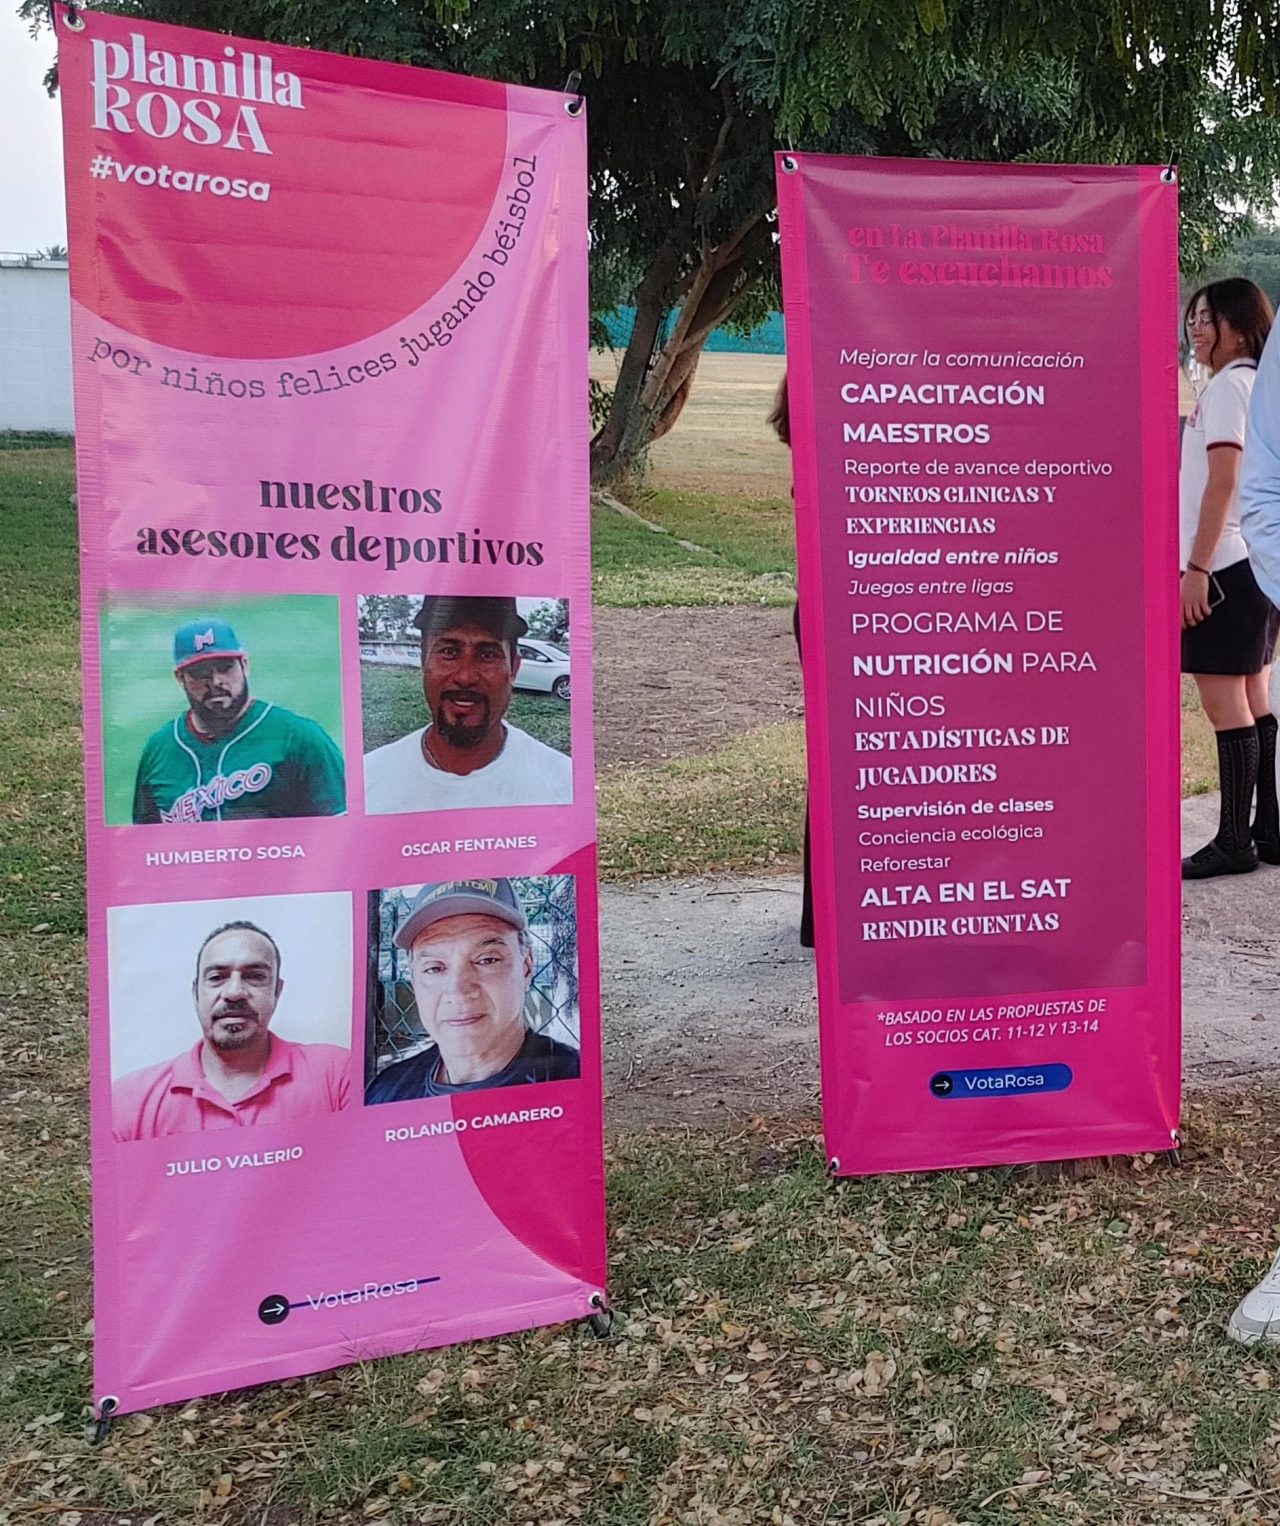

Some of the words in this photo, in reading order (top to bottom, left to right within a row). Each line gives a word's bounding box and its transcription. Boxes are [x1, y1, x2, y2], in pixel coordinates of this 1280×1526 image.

[90, 33, 305, 109] planilla
[90, 80, 273, 155] ROSA
[89, 155, 271, 202] #votarosa
[850, 226, 884, 248] en
[931, 224, 1033, 251] Planilla
[1040, 228, 1104, 254] Rosa
[88, 336, 152, 377] por
[162, 364, 265, 399] niños
[276, 352, 398, 398] felices
[400, 270, 496, 367] jugando
[483, 154, 536, 268] béisbol
[843, 252, 890, 286] Te
[900, 255, 1114, 289] escuchamos
[839, 348, 918, 369] Mejorar
[923, 349, 940, 367] la
[946, 351, 1084, 369] comunicación
[840, 381, 1045, 405] CAPACITACIÓN
[843, 422, 991, 444] MAESTROS
[844, 459, 920, 477] Reporte
[925, 459, 949, 475] de
[954, 462, 1020, 476] avance
[1025, 459, 1112, 478] deportivo
[259, 478, 442, 514] nuestros
[845, 486, 941, 503] TORNEOS
[943, 486, 1039, 503] CLINICAS
[1042, 486, 1057, 503] Y
[846, 517, 996, 535] EXPERIENCIAS
[136, 524, 320, 561] asesores
[330, 525, 544, 571] deportivos
[848, 548, 940, 568] Igualdad
[945, 550, 999, 564] entre
[1003, 548, 1059, 564] niños
[848, 580, 914, 598] Juegos
[918, 580, 967, 595] entre
[971, 578, 1014, 597] ligas
[852, 611, 1018, 634] PROGRAMA
[1026, 610, 1064, 632] DE
[853, 648, 1014, 676] NUTRICIÓN
[1021, 651, 1097, 673] PARA
[855, 692, 946, 718] NIÑOS
[855, 726, 1035, 751] ESTADÍSTICAS
[1040, 726, 1070, 746] DE
[855, 763, 997, 791] JUGADORES
[857, 800, 966, 821] Supervisión
[971, 800, 994, 814] de
[998, 798, 1054, 814] clases
[401, 839, 451, 857] OSCAR
[454, 835, 537, 853] FENTANES
[858, 827, 956, 847] Conciencia
[961, 824, 1044, 843] ecológica
[146, 847, 252, 867] HUMBERTO
[256, 844, 306, 861] SOSA
[860, 856, 951, 873] Reforestar
[861, 886, 932, 907] ALTA
[939, 882, 975, 903] EN
[983, 881, 1014, 901] EL
[1021, 878, 1071, 899] SAT
[862, 918, 947, 941] RENDIR
[951, 912, 1060, 936] CUENTAS
[946, 1008, 964, 1023] EN
[969, 1007, 994, 1022] LAS
[997, 1000, 1084, 1020] PROPUESTAS
[1087, 999, 1107, 1013] DE
[885, 1032, 912, 1047] LOS
[915, 1029, 969, 1044] SOCIOS
[973, 1027, 1001, 1042] CAT.
[1006, 1024, 1045, 1040] 11-12
[1048, 1023, 1057, 1037] Y
[1060, 1020, 1099, 1035] 13-14
[964, 1073, 1044, 1091] VotaRosa
[384, 1119, 467, 1143] ROLANDO
[471, 1105, 563, 1130] CAMARERO
[166, 1157, 222, 1177] JULIO
[225, 1146, 303, 1169] VALERIO
[307, 1277, 419, 1312] VotaRosa
